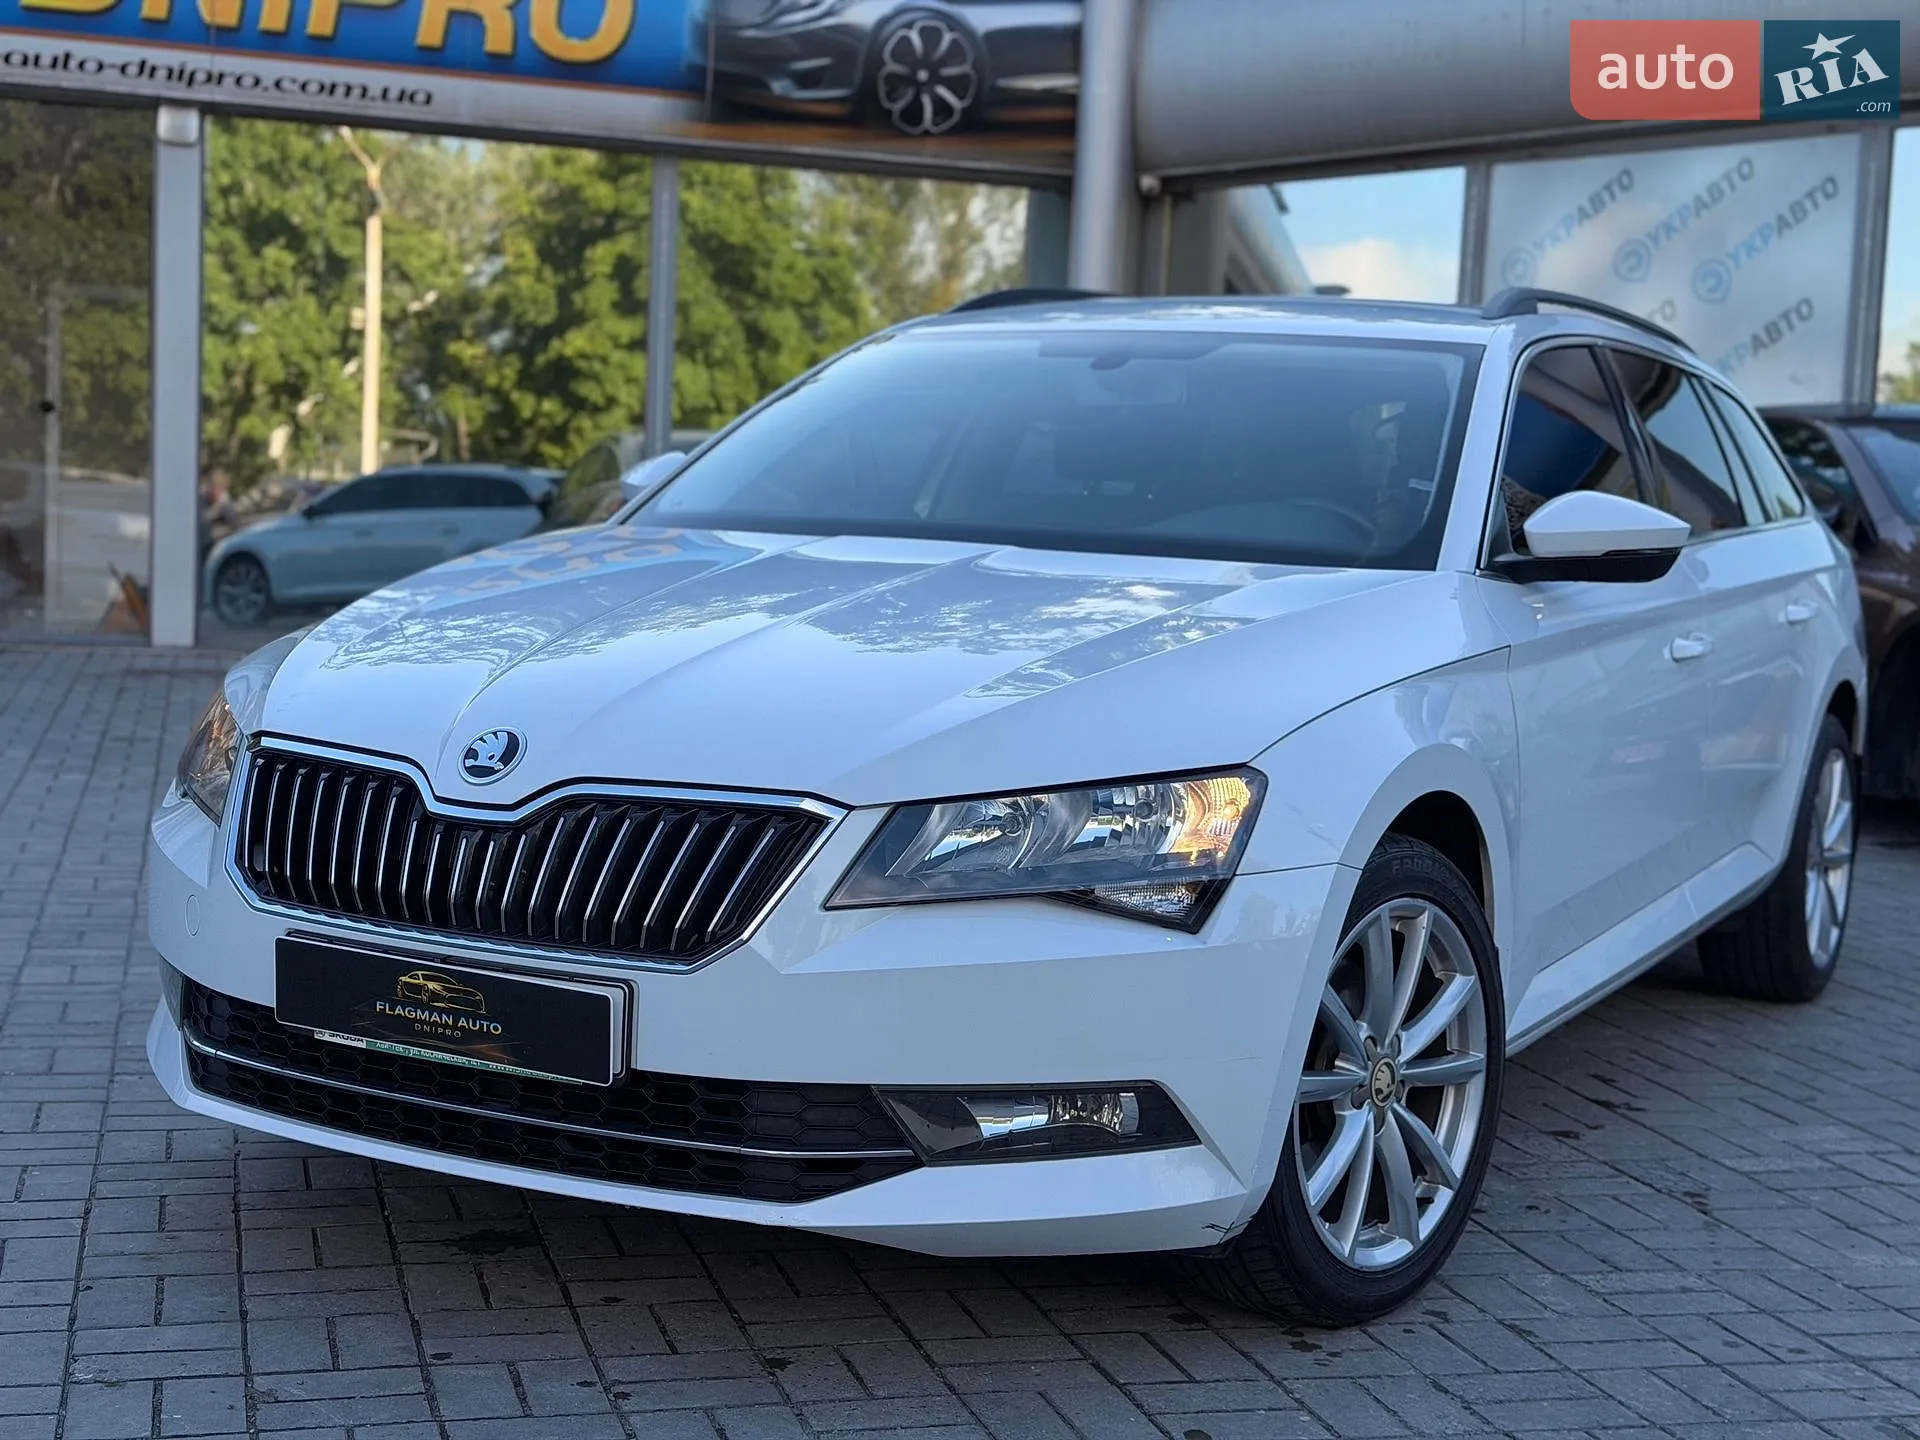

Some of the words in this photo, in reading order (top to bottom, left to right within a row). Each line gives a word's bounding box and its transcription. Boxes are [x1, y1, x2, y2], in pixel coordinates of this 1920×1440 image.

[375, 1000, 454, 1027] FLAGMAN
[456, 1015, 503, 1036] AUTO
[414, 1022, 462, 1039] DNIPRO
